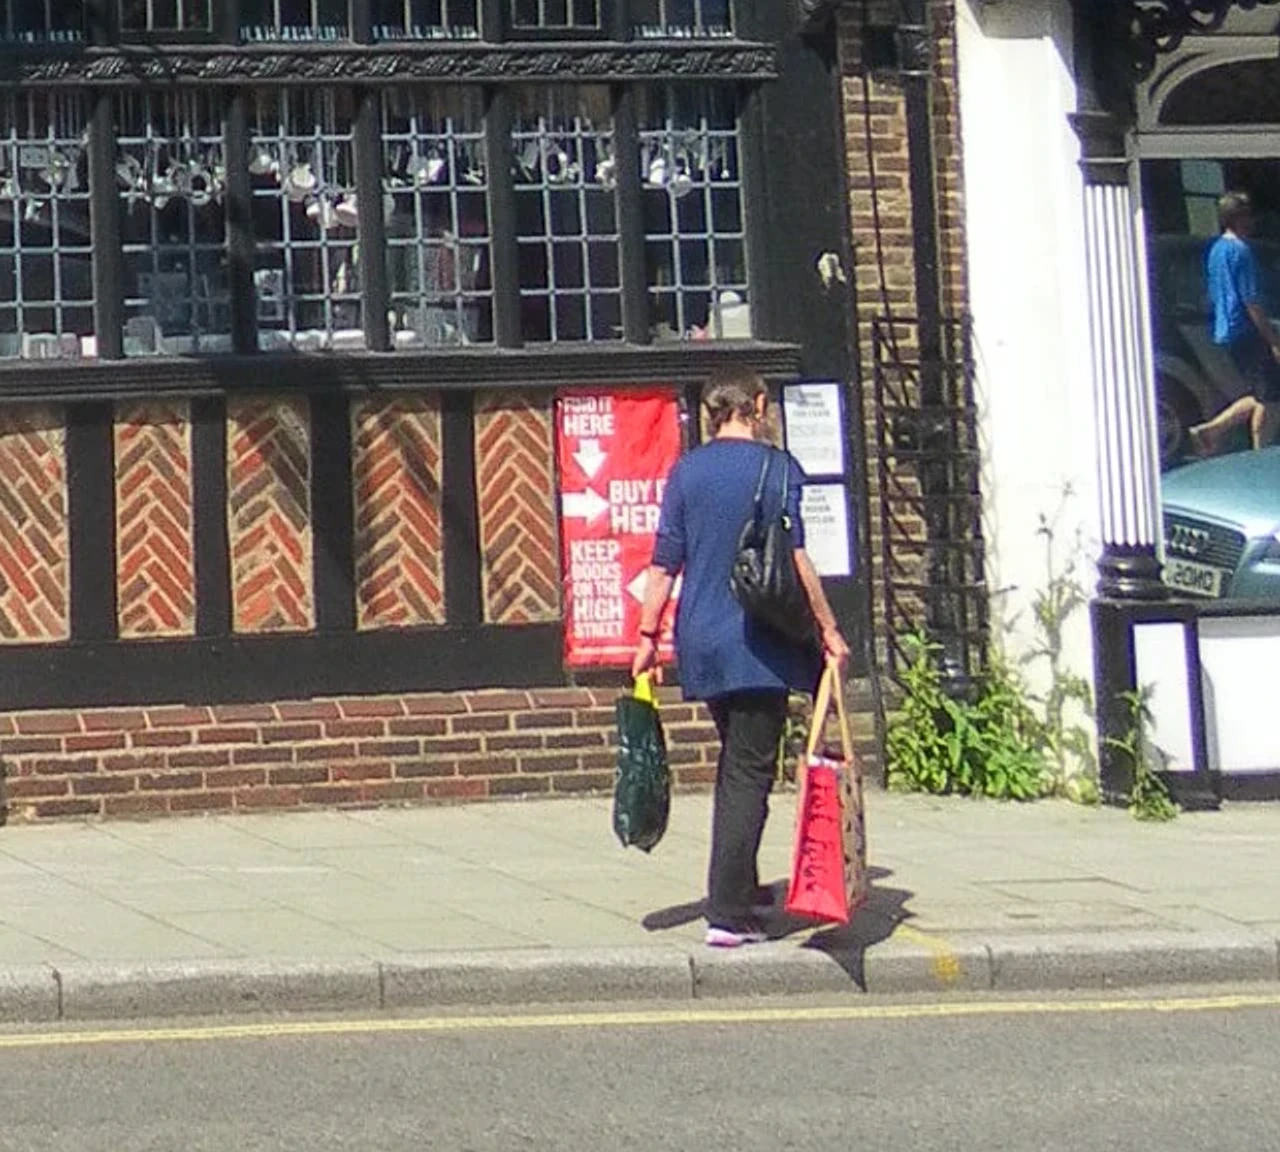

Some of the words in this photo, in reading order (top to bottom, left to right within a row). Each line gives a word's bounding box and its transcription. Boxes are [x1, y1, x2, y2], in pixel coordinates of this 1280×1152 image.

[564, 413, 616, 438] HERE
[609, 479, 653, 505] BUY
[610, 503, 662, 535] HER
[570, 539, 621, 563] KEEP
[571, 560, 623, 581] BOOKS
[573, 596, 625, 622] HIGH
